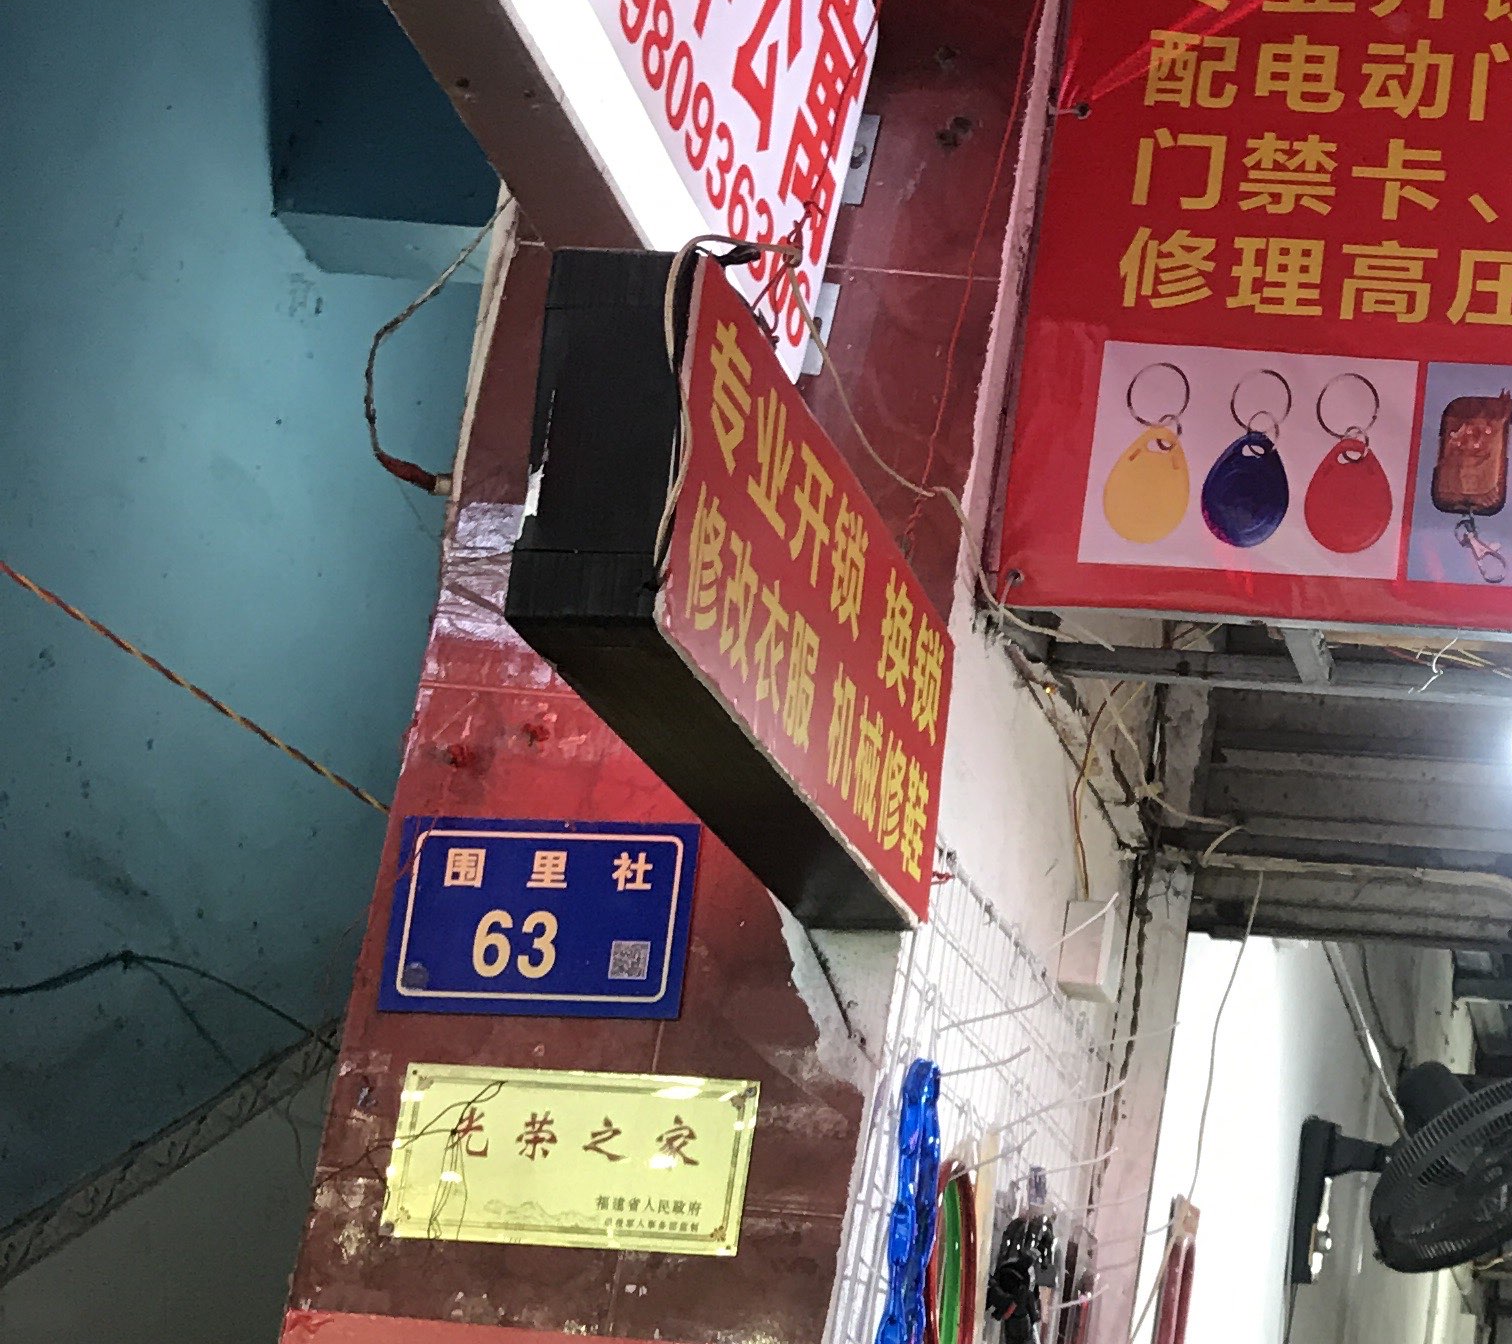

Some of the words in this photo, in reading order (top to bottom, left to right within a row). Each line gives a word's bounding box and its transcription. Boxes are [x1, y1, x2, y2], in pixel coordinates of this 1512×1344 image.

[443, 847, 653, 893] 围里社
[471, 908, 559, 980] 63
[453, 1105, 701, 1168] 光荣之家
